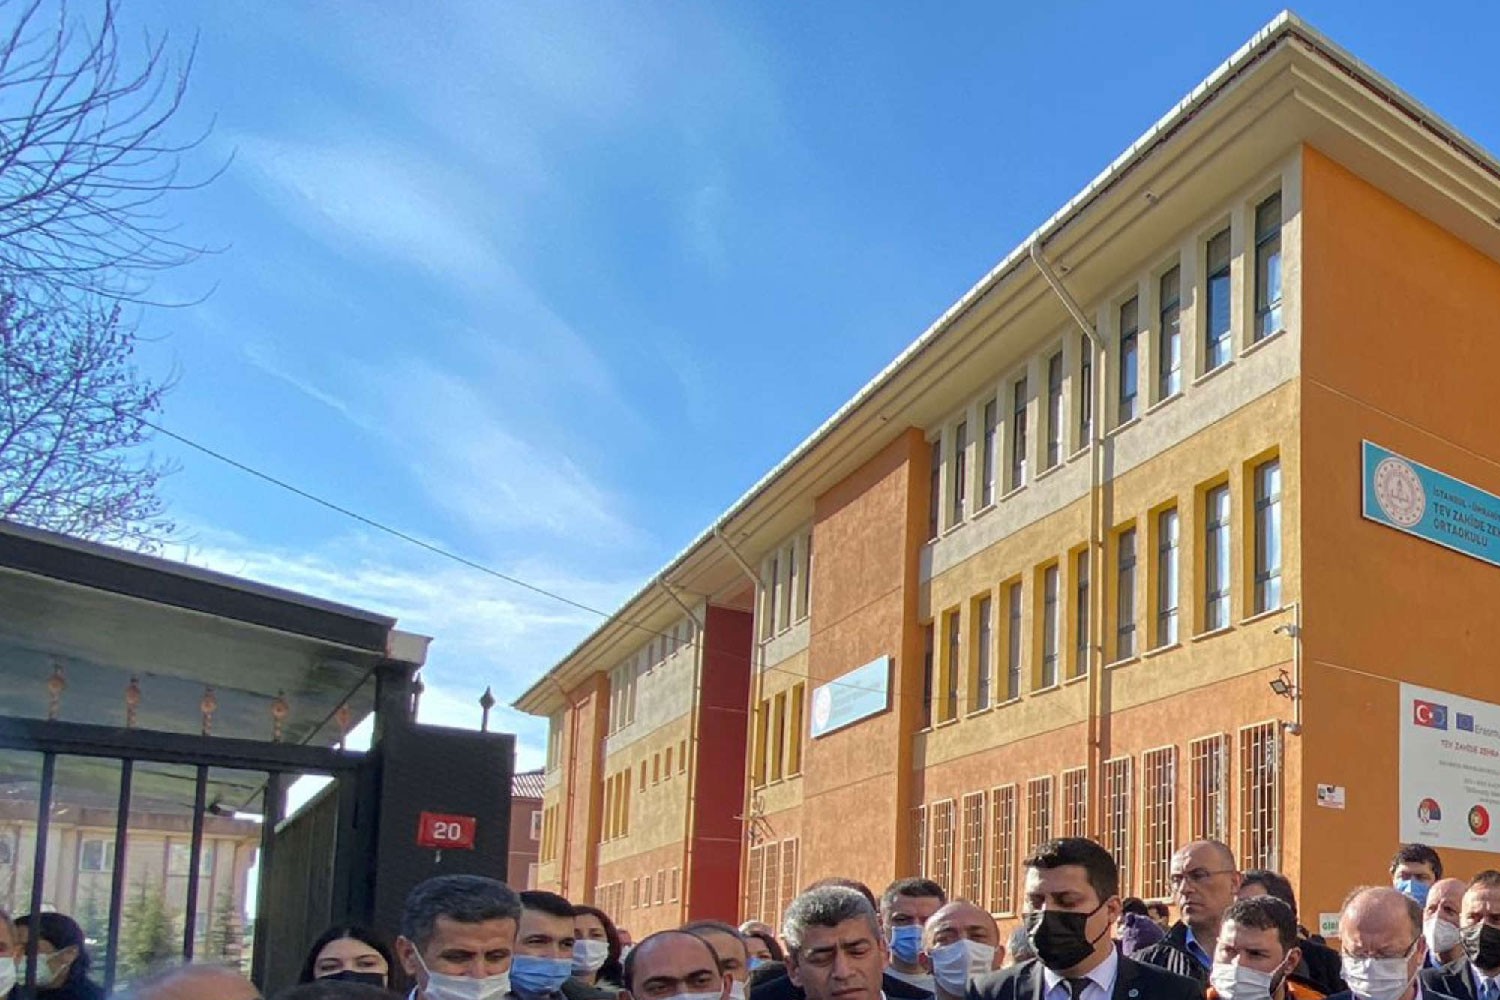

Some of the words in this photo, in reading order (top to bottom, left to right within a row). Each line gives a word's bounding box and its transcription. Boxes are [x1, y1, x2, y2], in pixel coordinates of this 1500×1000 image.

[1432, 501, 1451, 518] TEV
[1433, 518, 1487, 547] ORTAOKULU
[433, 821, 461, 841] 20
